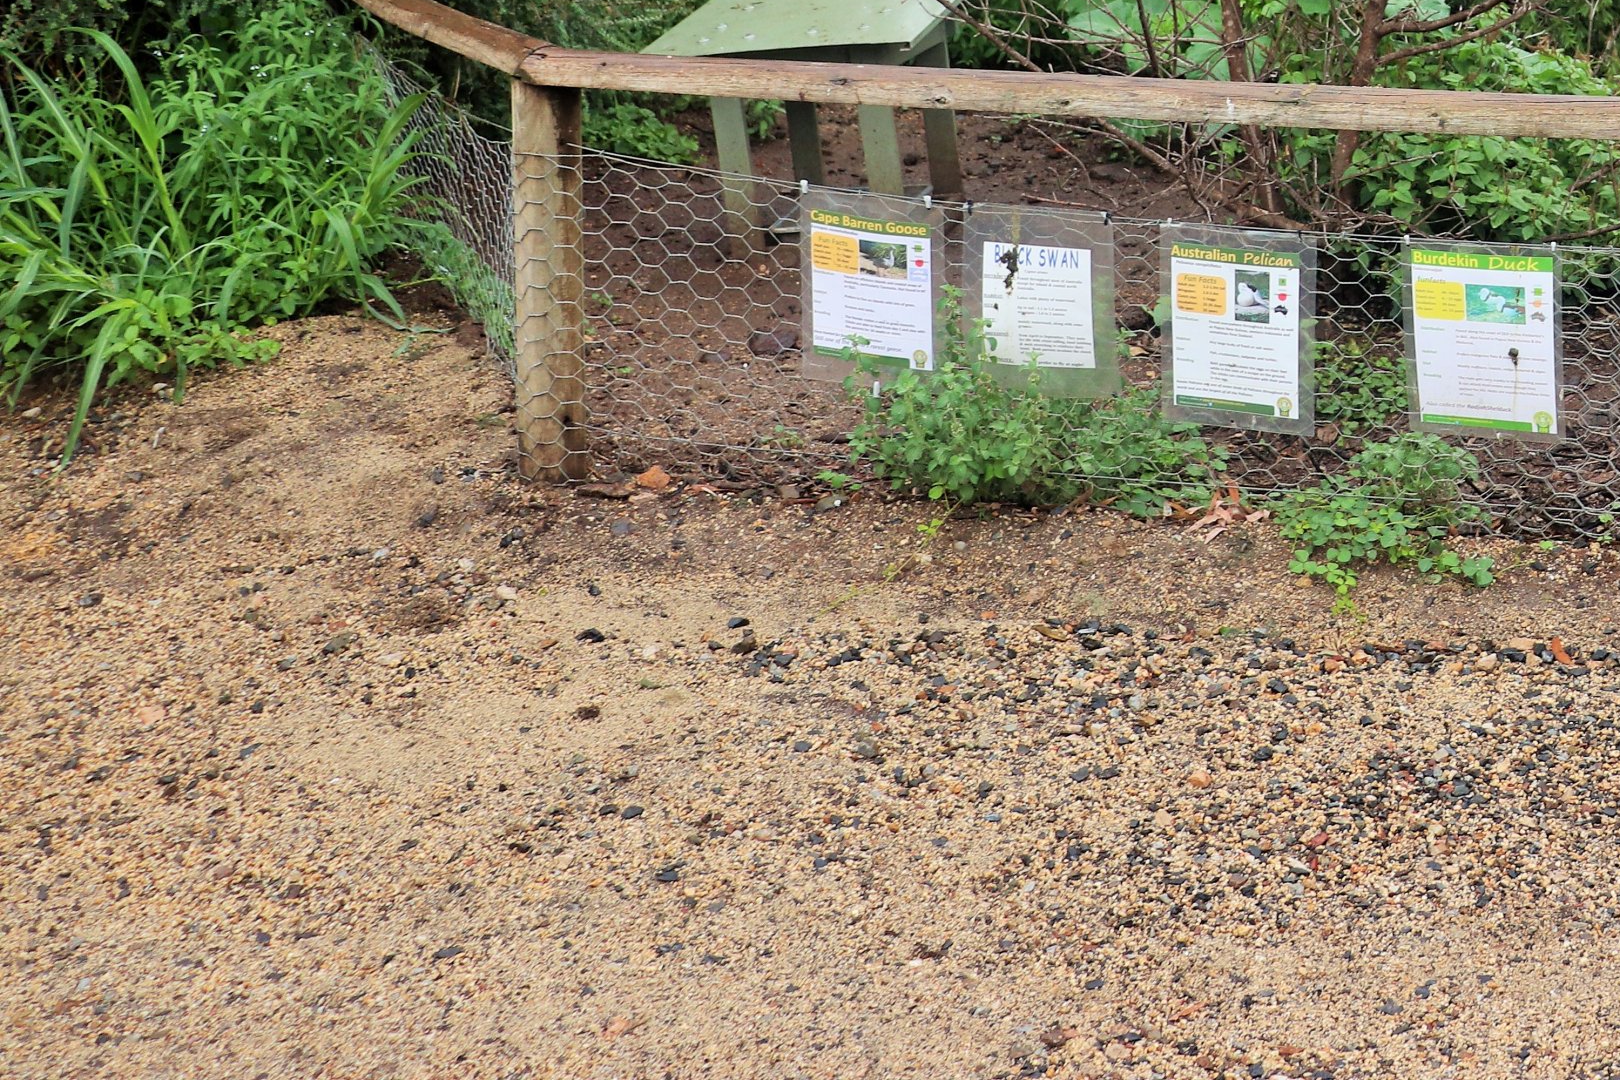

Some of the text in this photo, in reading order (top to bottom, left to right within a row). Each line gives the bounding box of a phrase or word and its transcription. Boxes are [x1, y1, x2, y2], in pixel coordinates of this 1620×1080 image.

[810, 210, 840, 225] Cape
[842, 215, 883, 232] Barren
[886, 222, 927, 236] Goose
[994, 244, 1079, 269] BCK SWAN
[1171, 245, 1294, 267] Australian Pelican
[1413, 250, 1540, 272] Burdekin Duck
